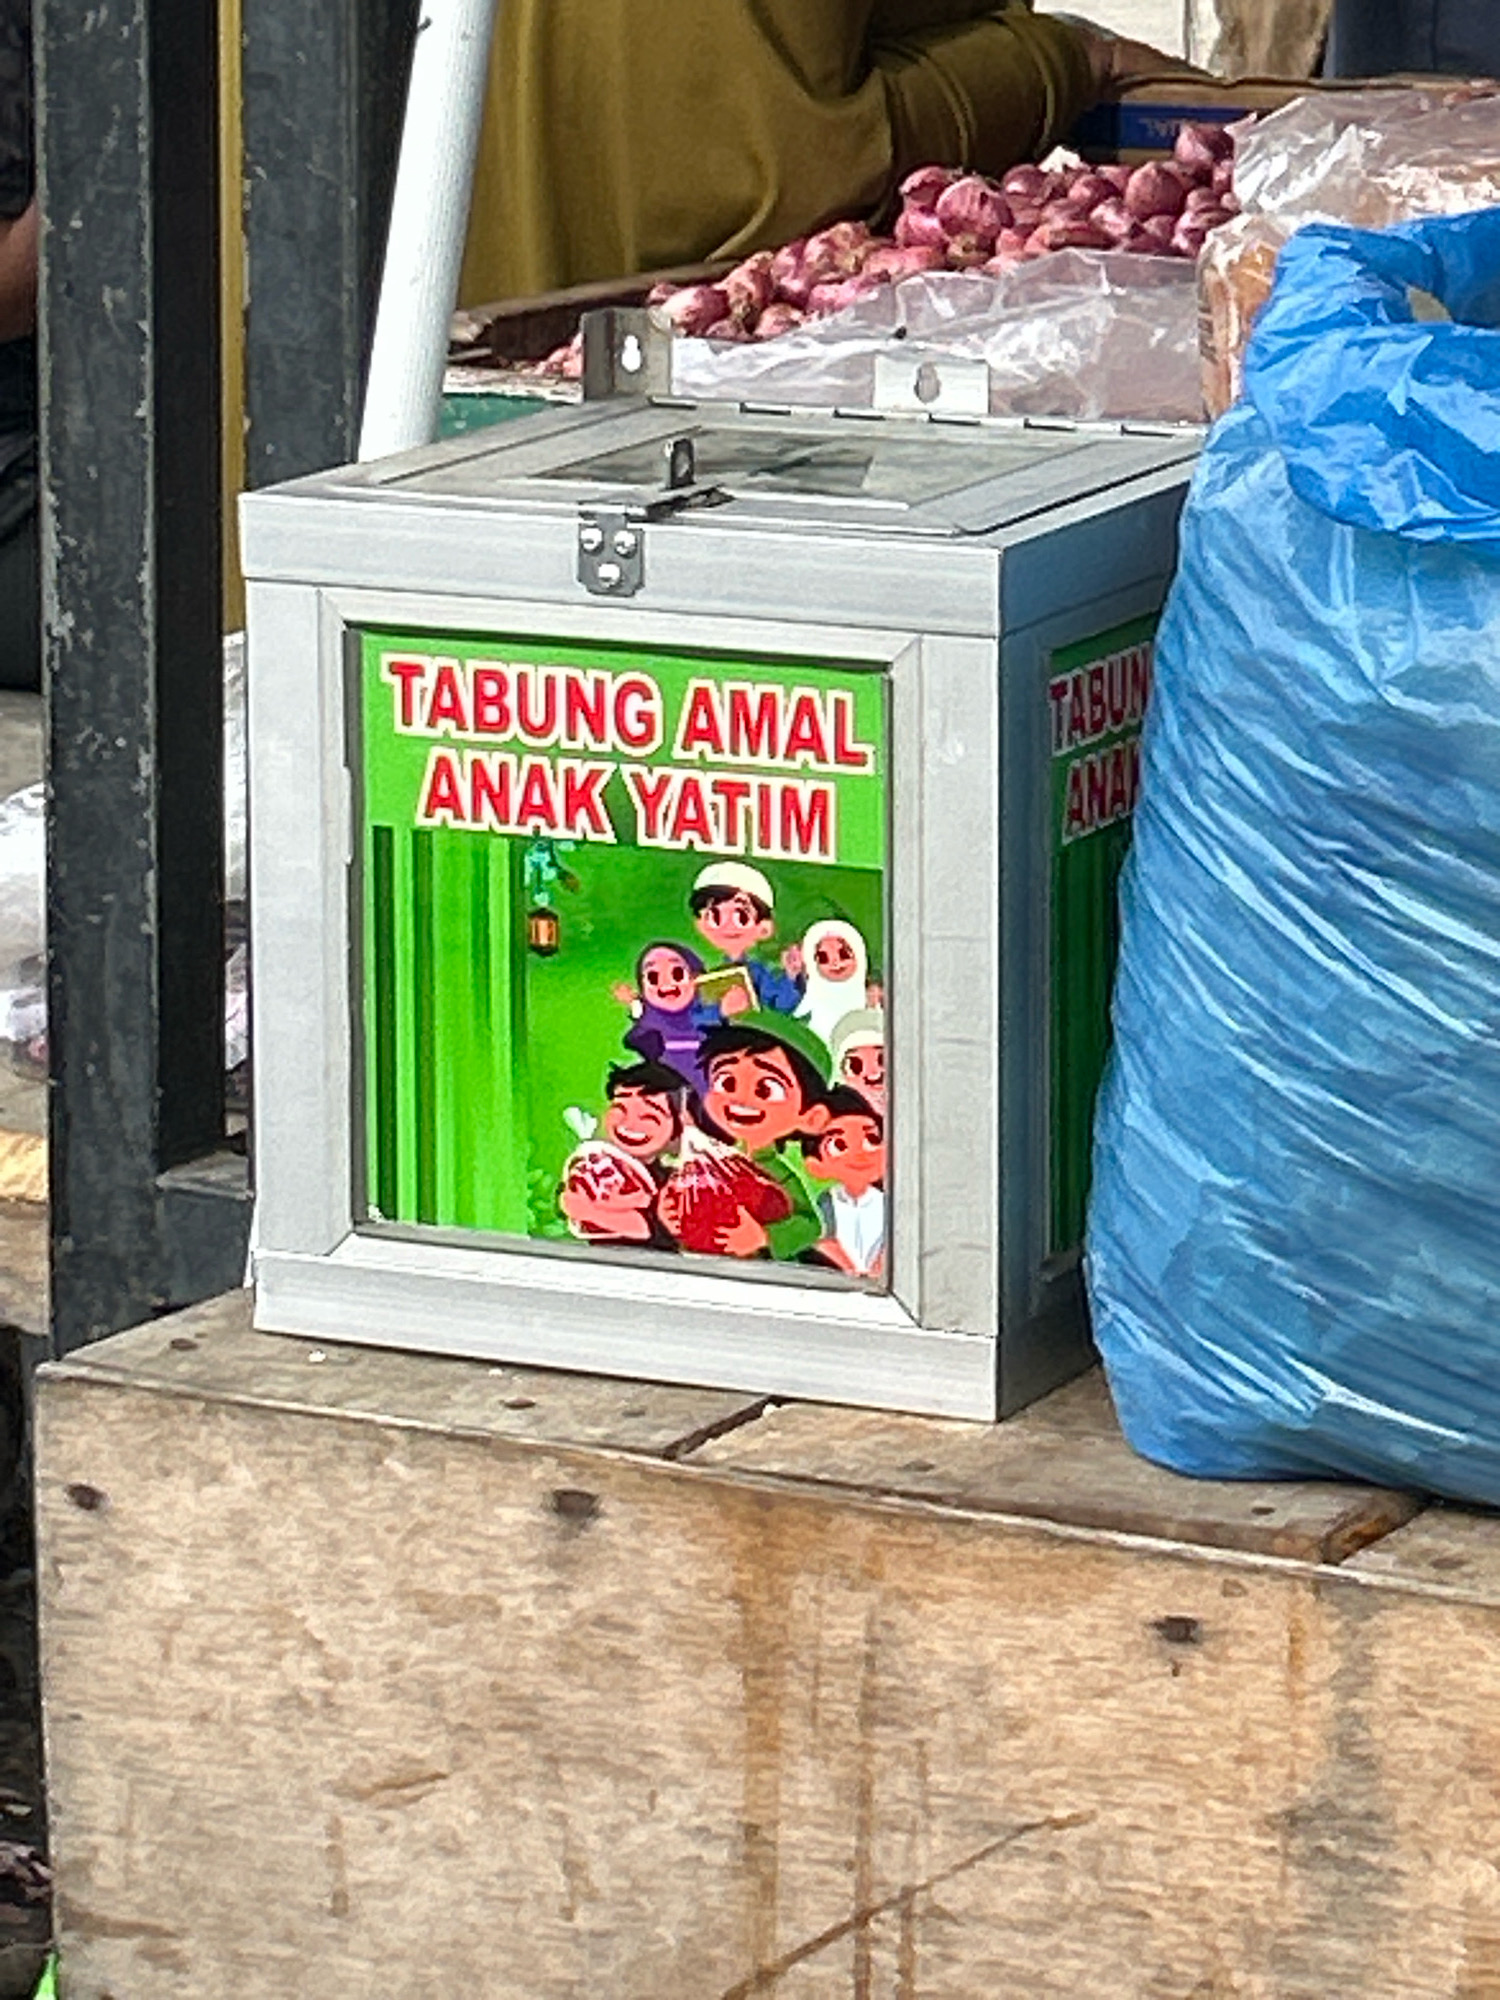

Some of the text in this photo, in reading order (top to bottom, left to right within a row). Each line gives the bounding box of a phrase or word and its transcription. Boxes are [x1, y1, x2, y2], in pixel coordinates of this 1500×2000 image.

[384, 656, 874, 772] TABUNG AMAL
[1048, 643, 1152, 757] TABUN
[420, 750, 835, 860] ANAK YATIM
